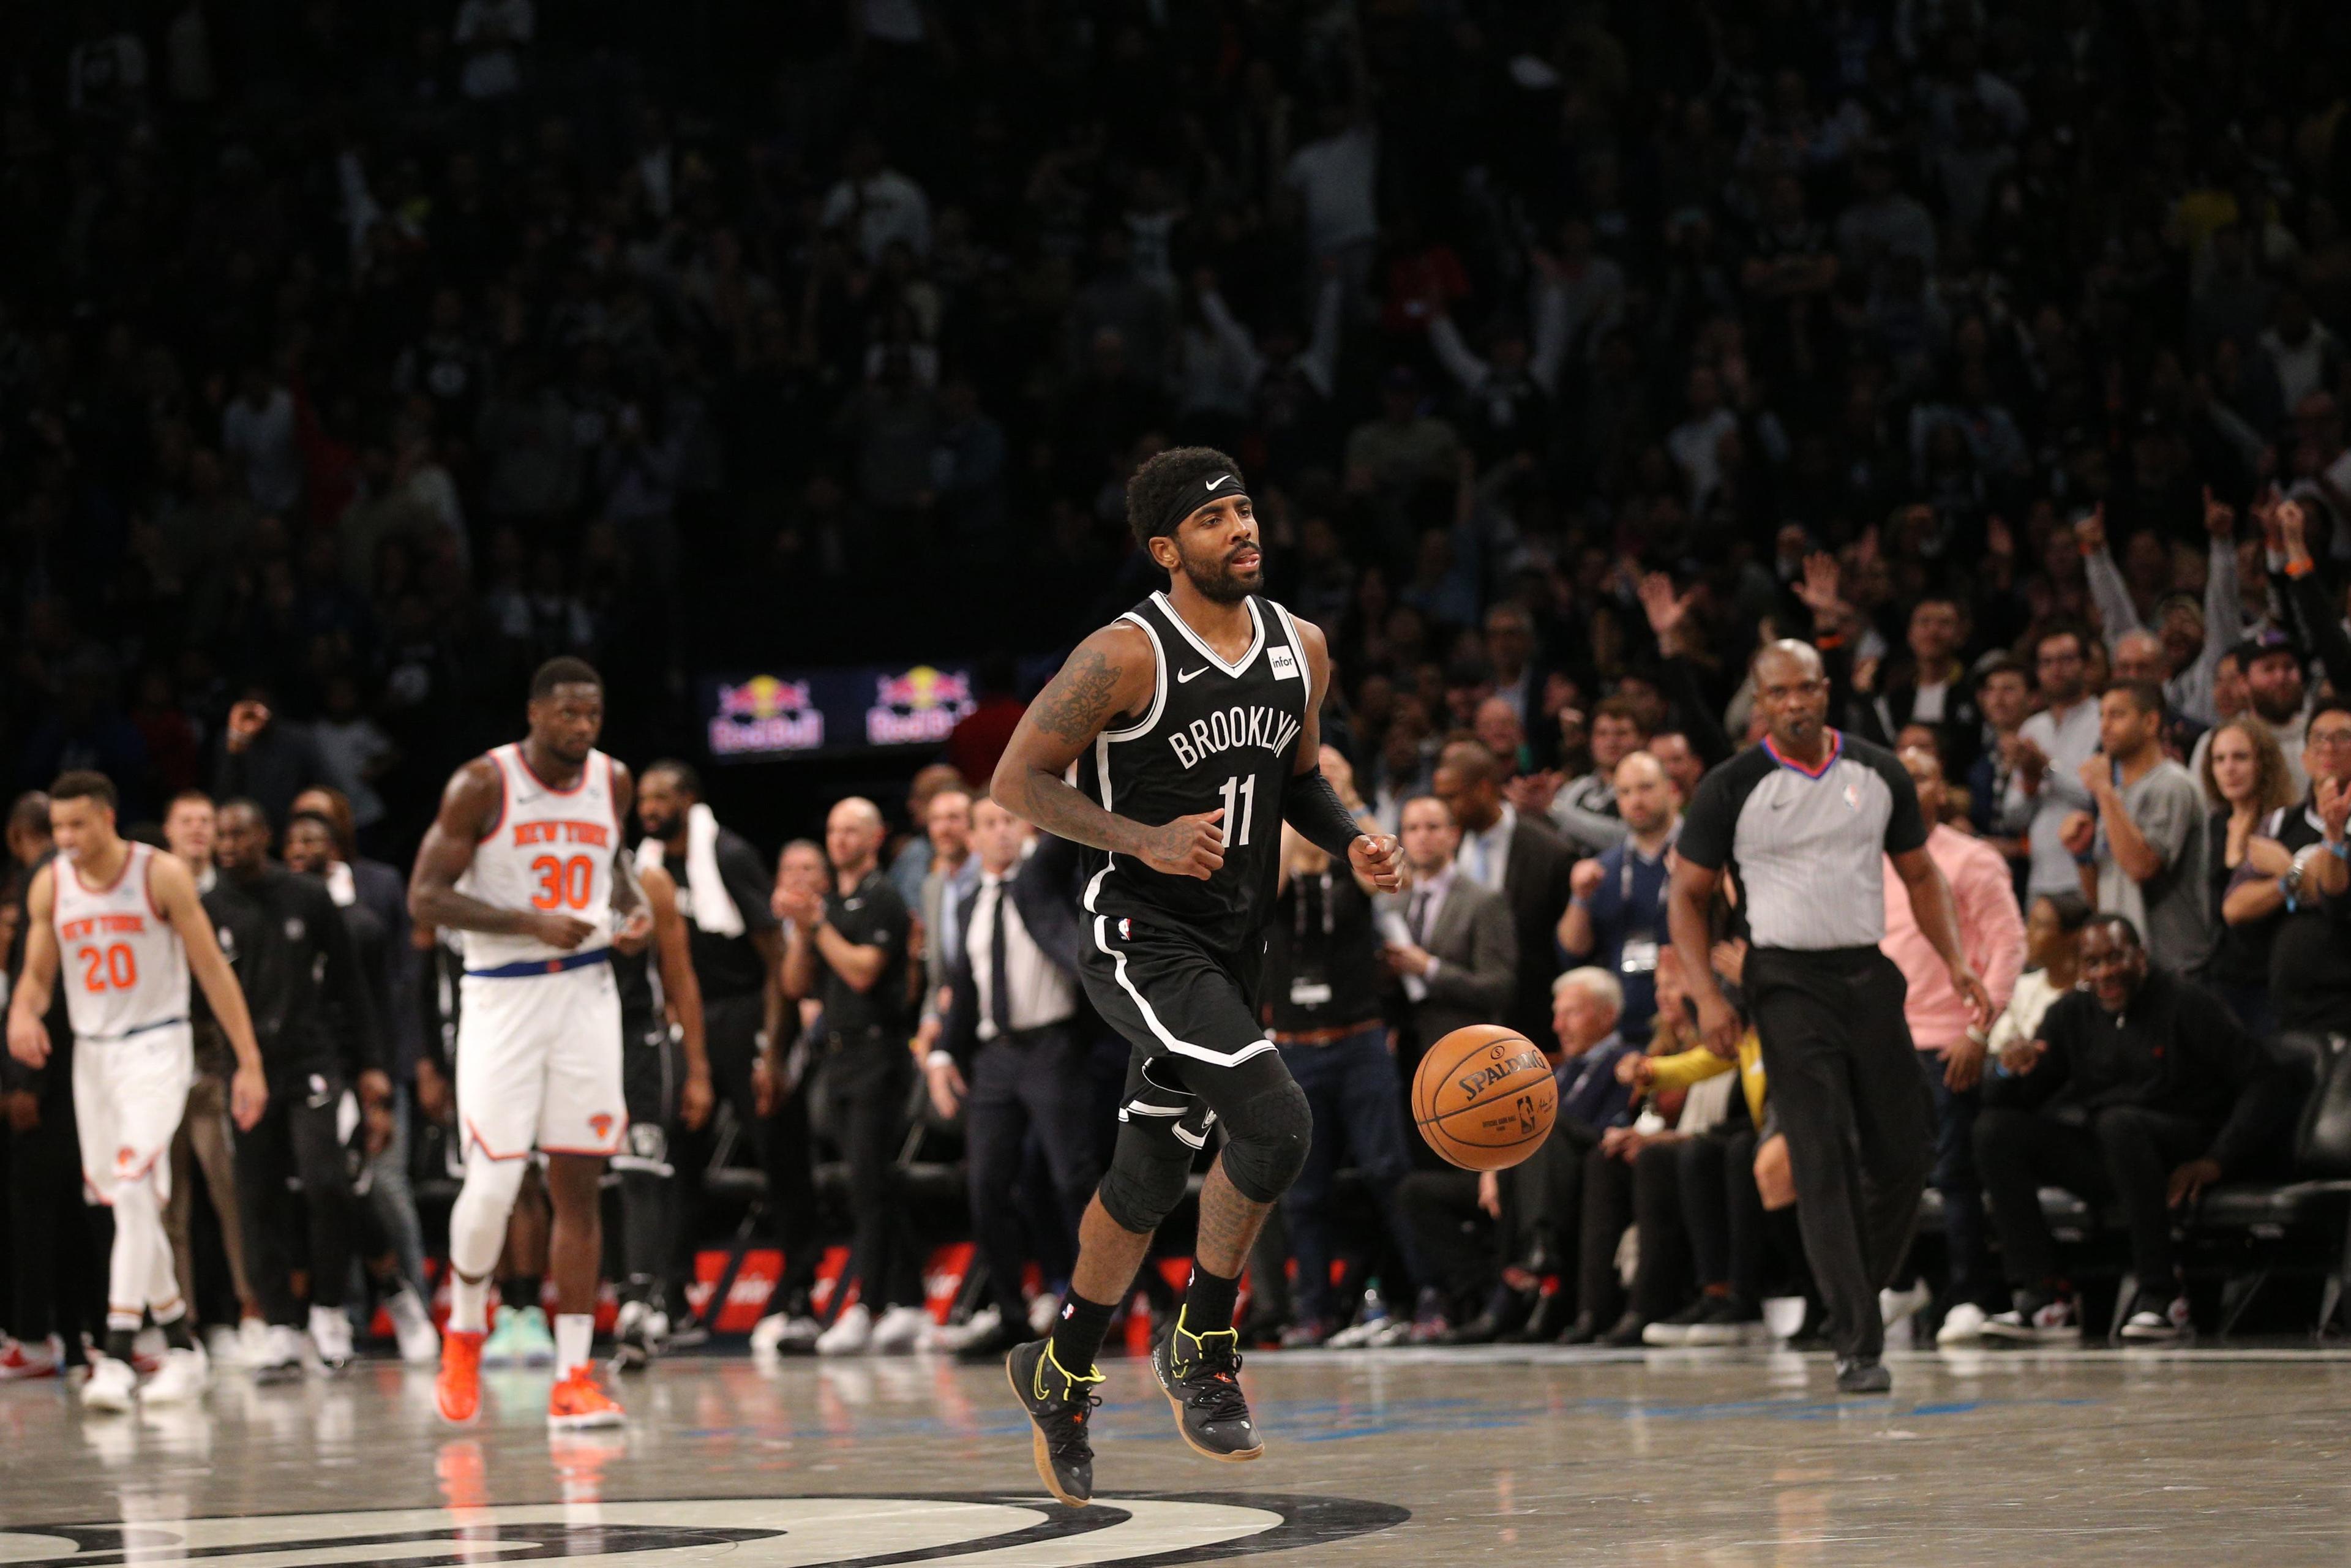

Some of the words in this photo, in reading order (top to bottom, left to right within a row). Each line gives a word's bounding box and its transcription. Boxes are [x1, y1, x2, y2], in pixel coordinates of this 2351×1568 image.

[1272, 656, 1292, 669] infor
[1168, 706, 1301, 770] BROOKLYN
[514, 820, 558, 849] NEW
[564, 820, 609, 850] YORK
[1218, 773, 1255, 848] 11
[531, 854, 594, 910] 30
[78, 942, 138, 992] 20
[1458, 1049, 1547, 1101] SPALDING
